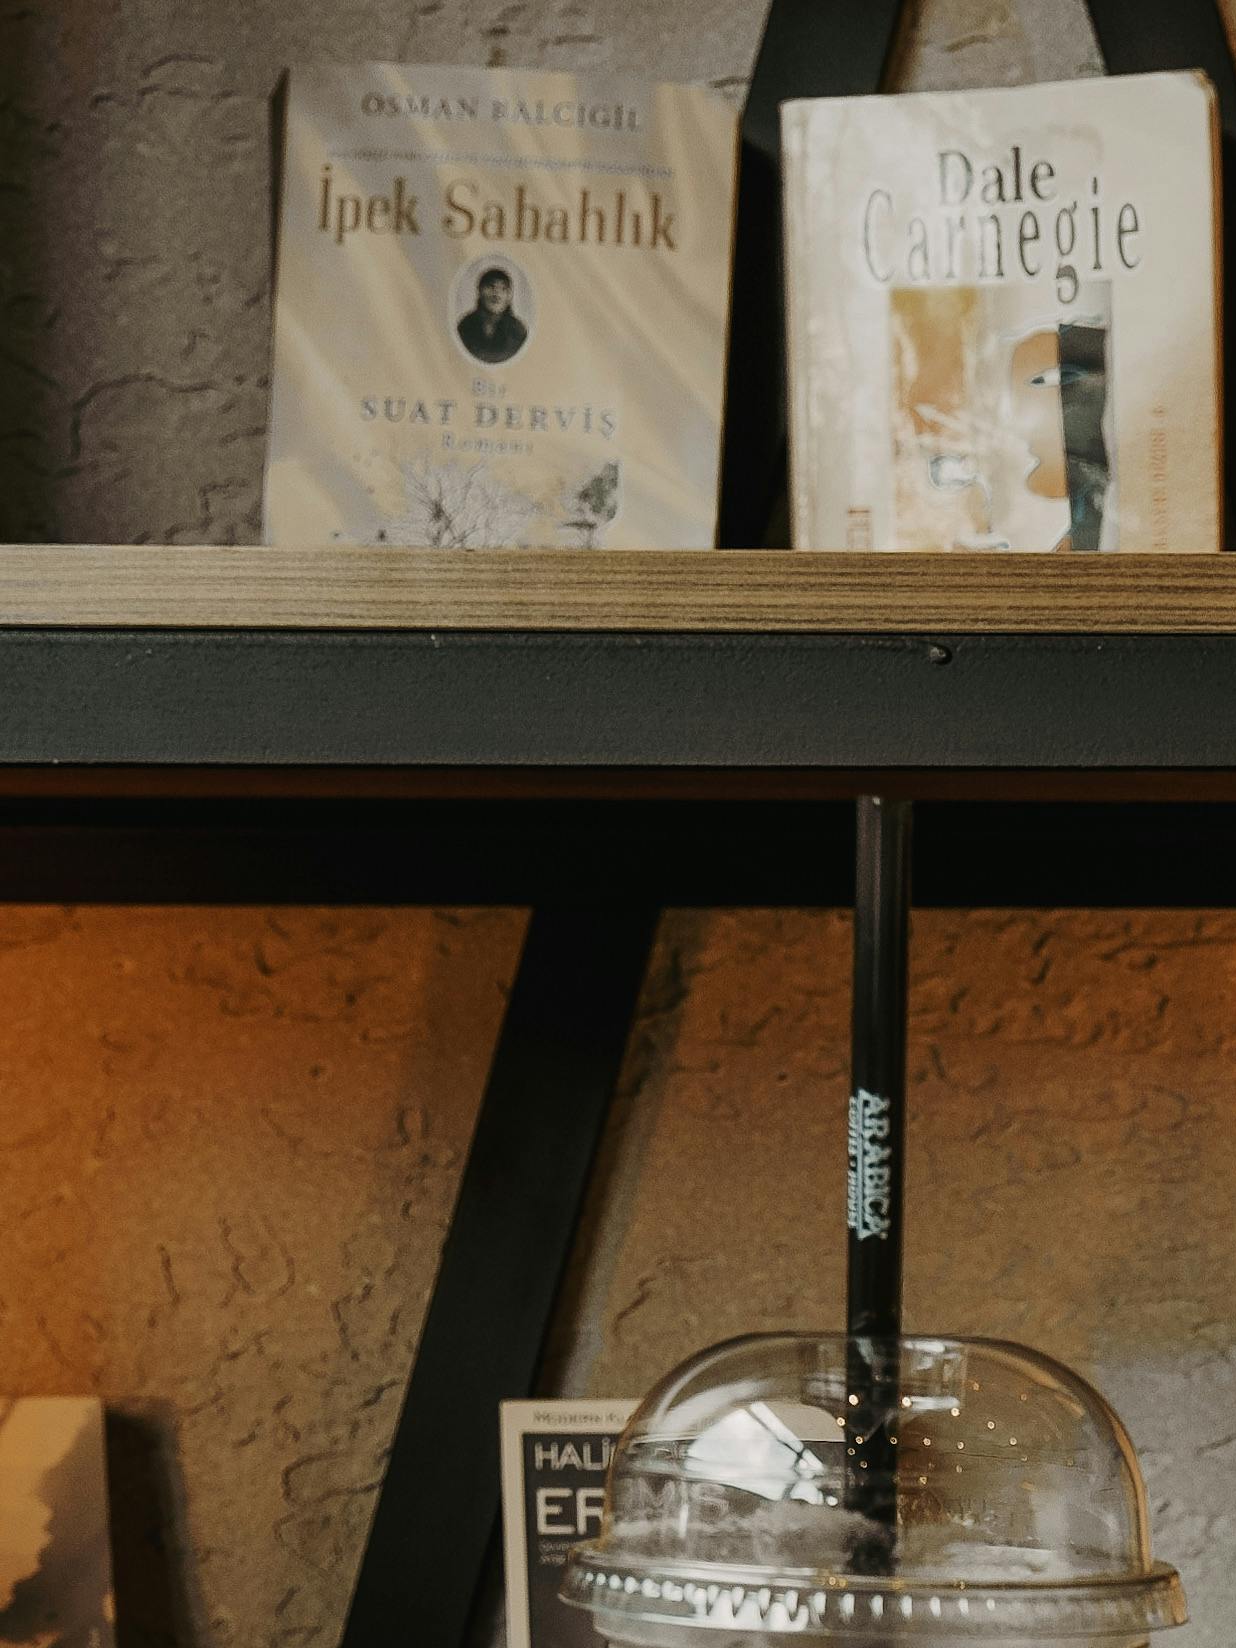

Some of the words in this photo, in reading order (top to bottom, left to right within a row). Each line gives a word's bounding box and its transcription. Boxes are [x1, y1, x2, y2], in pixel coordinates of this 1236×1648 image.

[318, 164, 421, 246] İpek
[441, 179, 678, 252] Sabahlık
[938, 146, 1056, 205] Dale
[864, 176, 1142, 305] Carnegie
[360, 397, 456, 425] SUAT
[857, 1087, 892, 1241] ARABICA
